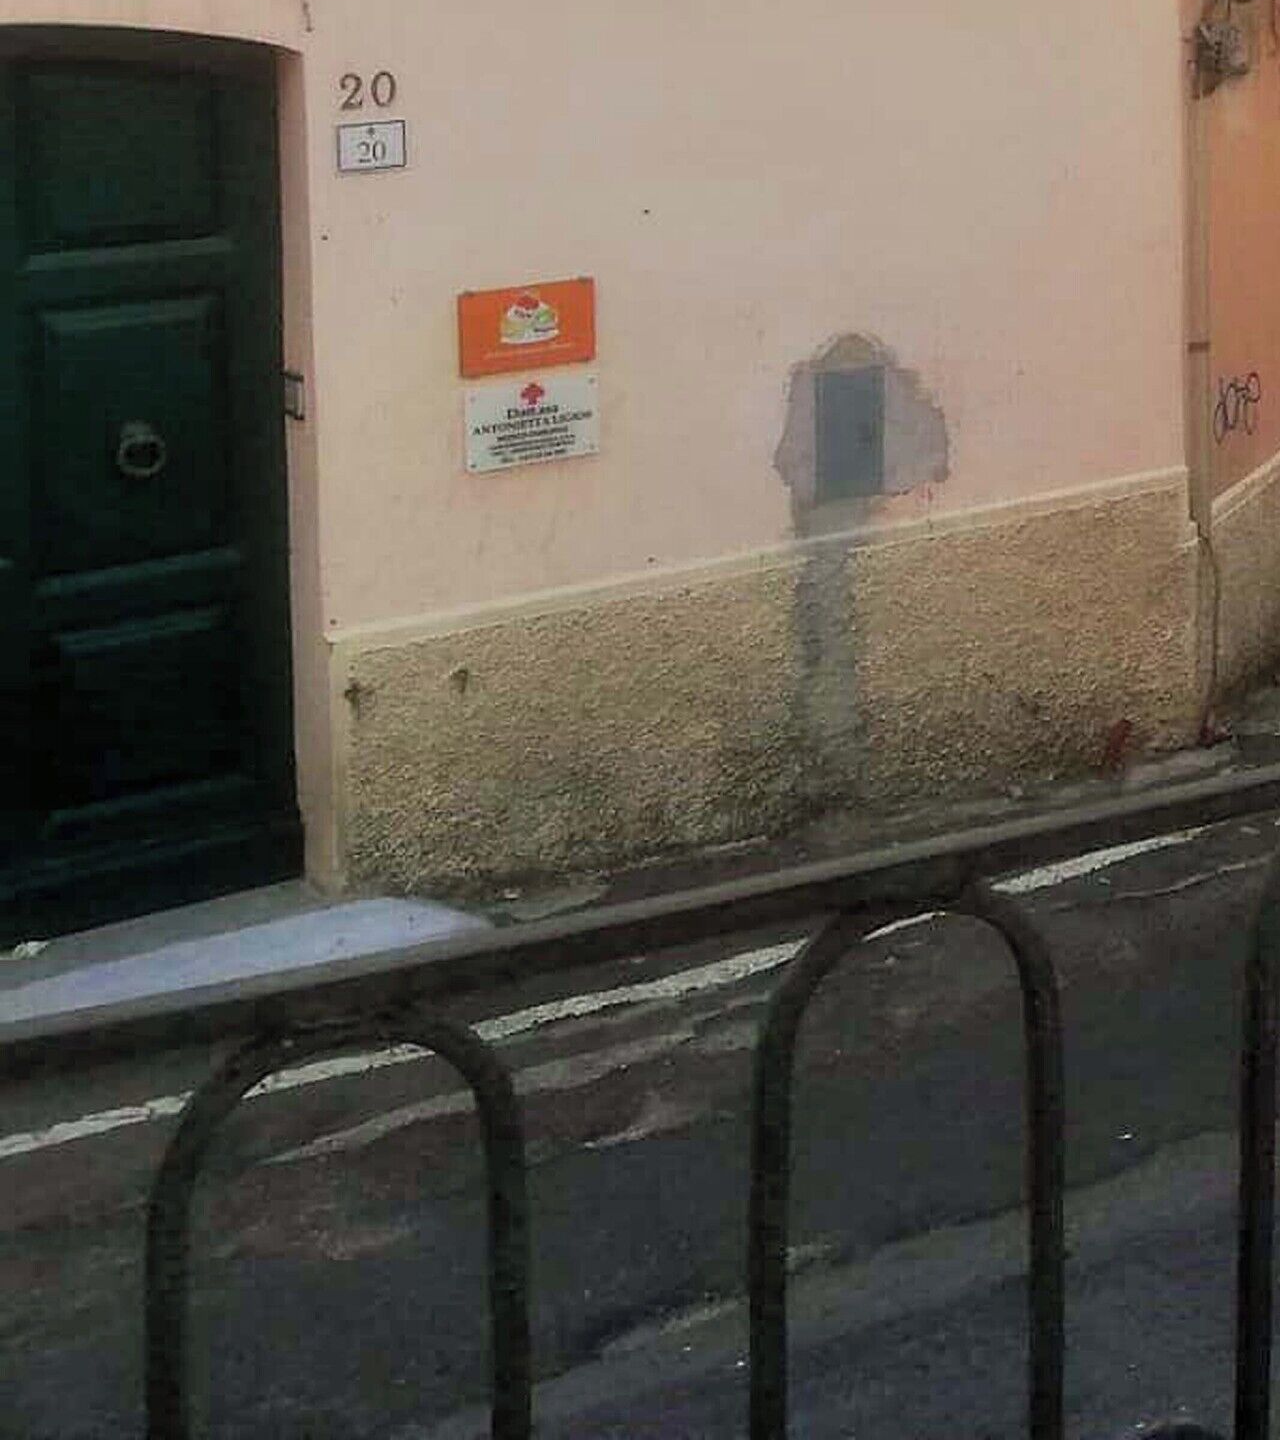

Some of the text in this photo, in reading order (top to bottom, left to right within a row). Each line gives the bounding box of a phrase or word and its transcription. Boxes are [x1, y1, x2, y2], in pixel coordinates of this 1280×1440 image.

[340, 71, 397, 111] 20
[357, 140, 387, 164] 20
[472, 417, 551, 436] ANTONIETTA
